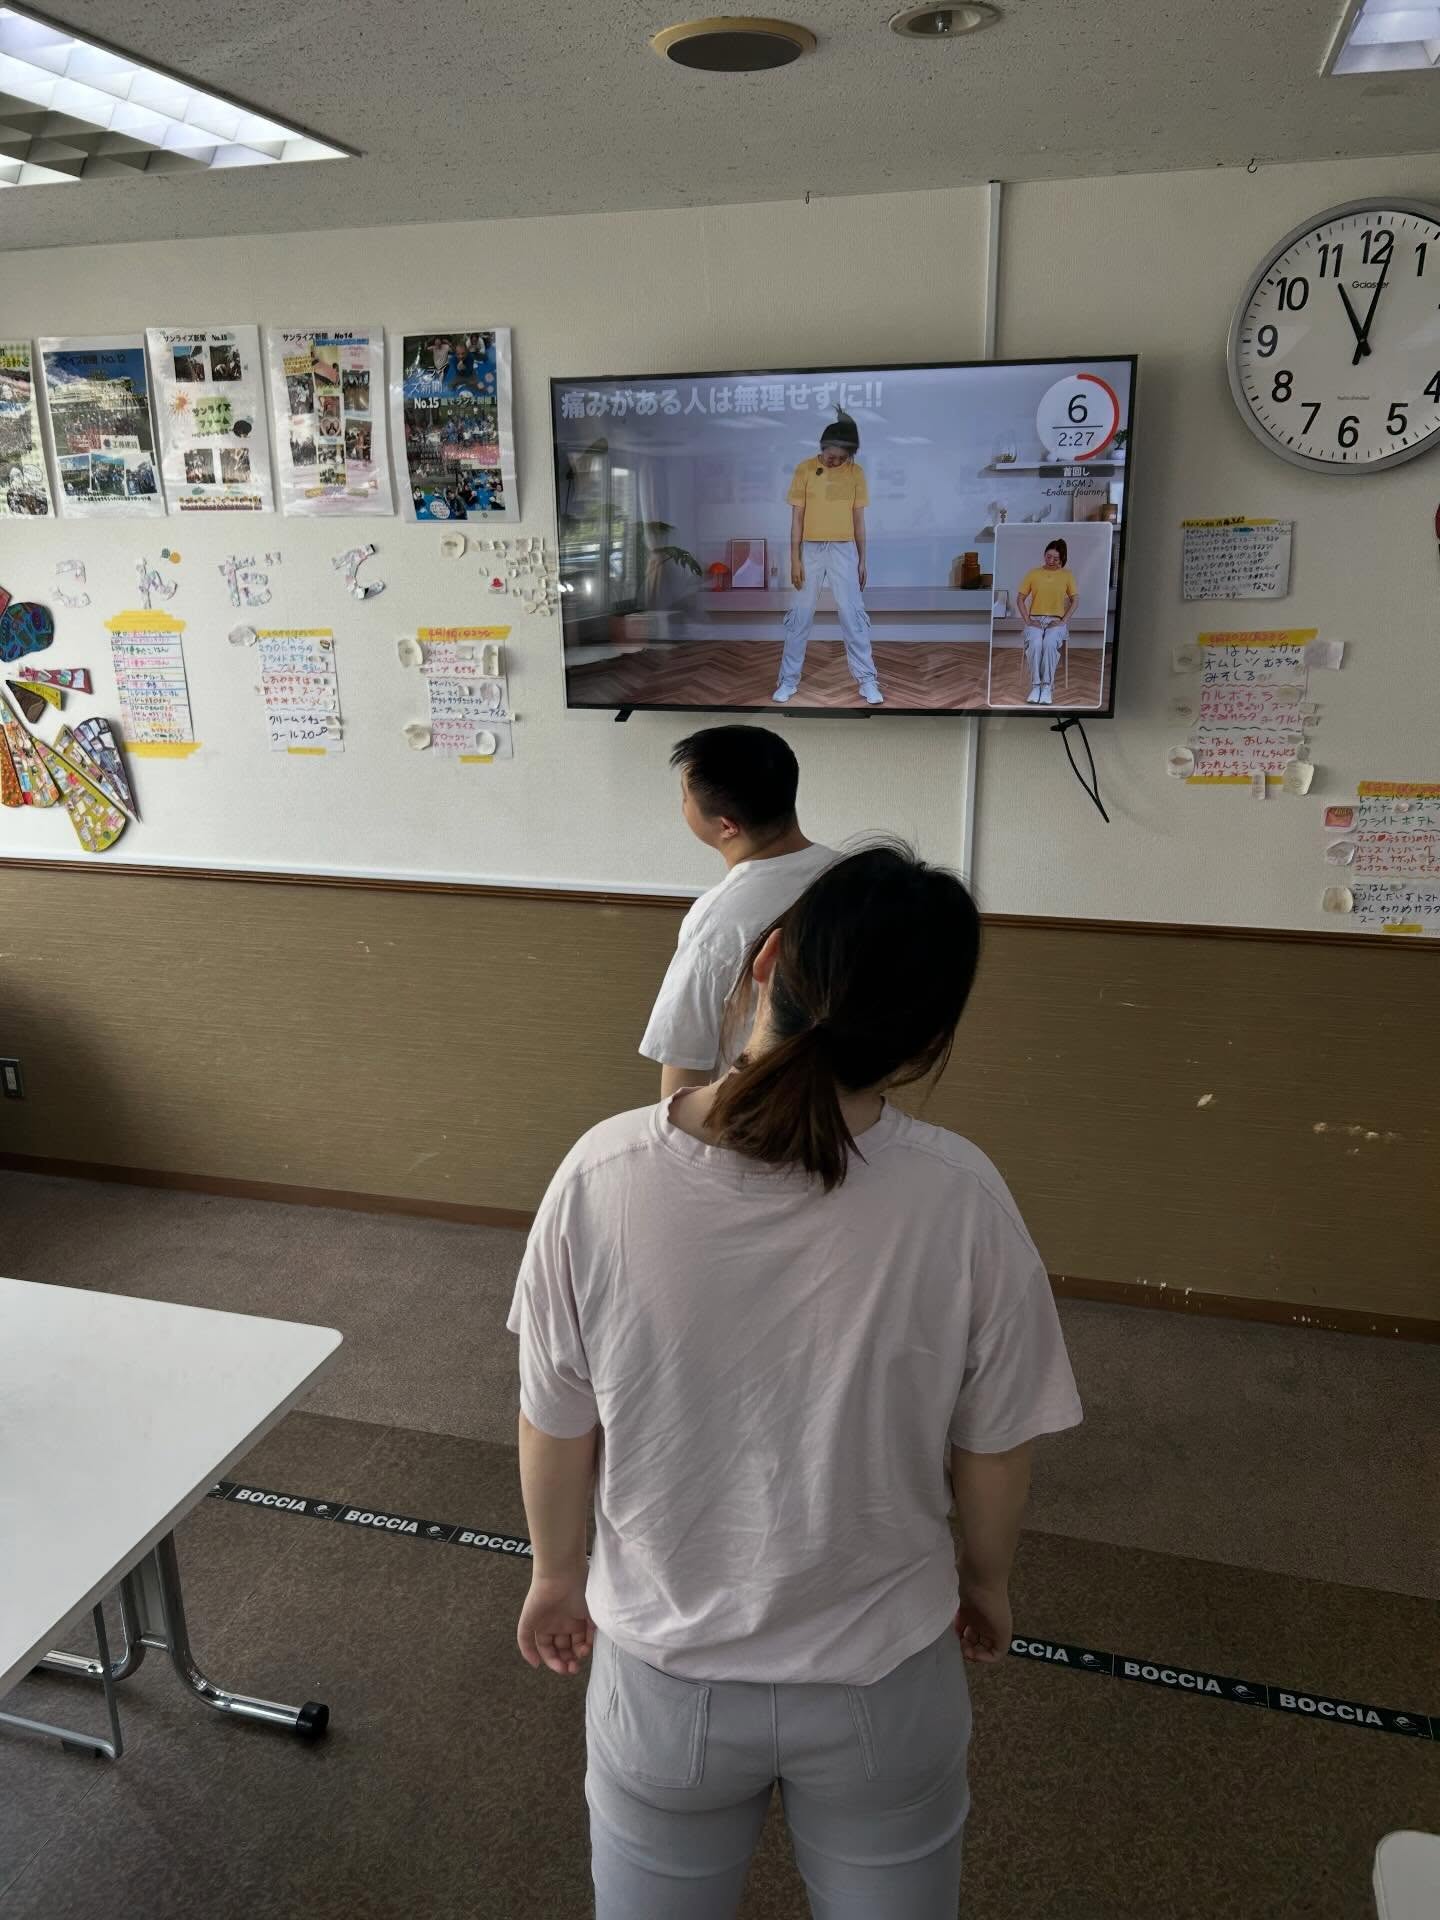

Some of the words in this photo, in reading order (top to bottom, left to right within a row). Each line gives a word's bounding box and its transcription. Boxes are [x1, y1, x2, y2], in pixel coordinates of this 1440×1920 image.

[1317, 243, 1344, 278] 11
[1360, 229, 1395, 265] 12
[1414, 242, 1428, 277] 1
[1276, 276, 1310, 311] 10
[282, 332, 328, 341] サンライズ新聞
[1256, 324, 1279, 358] 9
[562, 382, 883, 419] 痛みがある人は無理せずに!!
[1271, 370, 1294, 403] 8
[1423, 372, 1440, 404] 4
[1068, 394, 1088, 423] 6
[1301, 402, 1322, 435] 7
[1386, 402, 1409, 436] 5
[1058, 432, 1095, 446] 2:27
[1337, 415, 1361, 449] 6
[1063, 467, 1090, 477] 首回し
[235, 1488, 307, 1512] BOCCIA
[344, 1509, 419, 1534] BOCCIA
[459, 1531, 534, 1556] BOCCIA
[1010, 1638, 1070, 1663] CCIA
[1124, 1660, 1223, 1694] BOCCIA
[1279, 1692, 1383, 1726] BOCCIA
